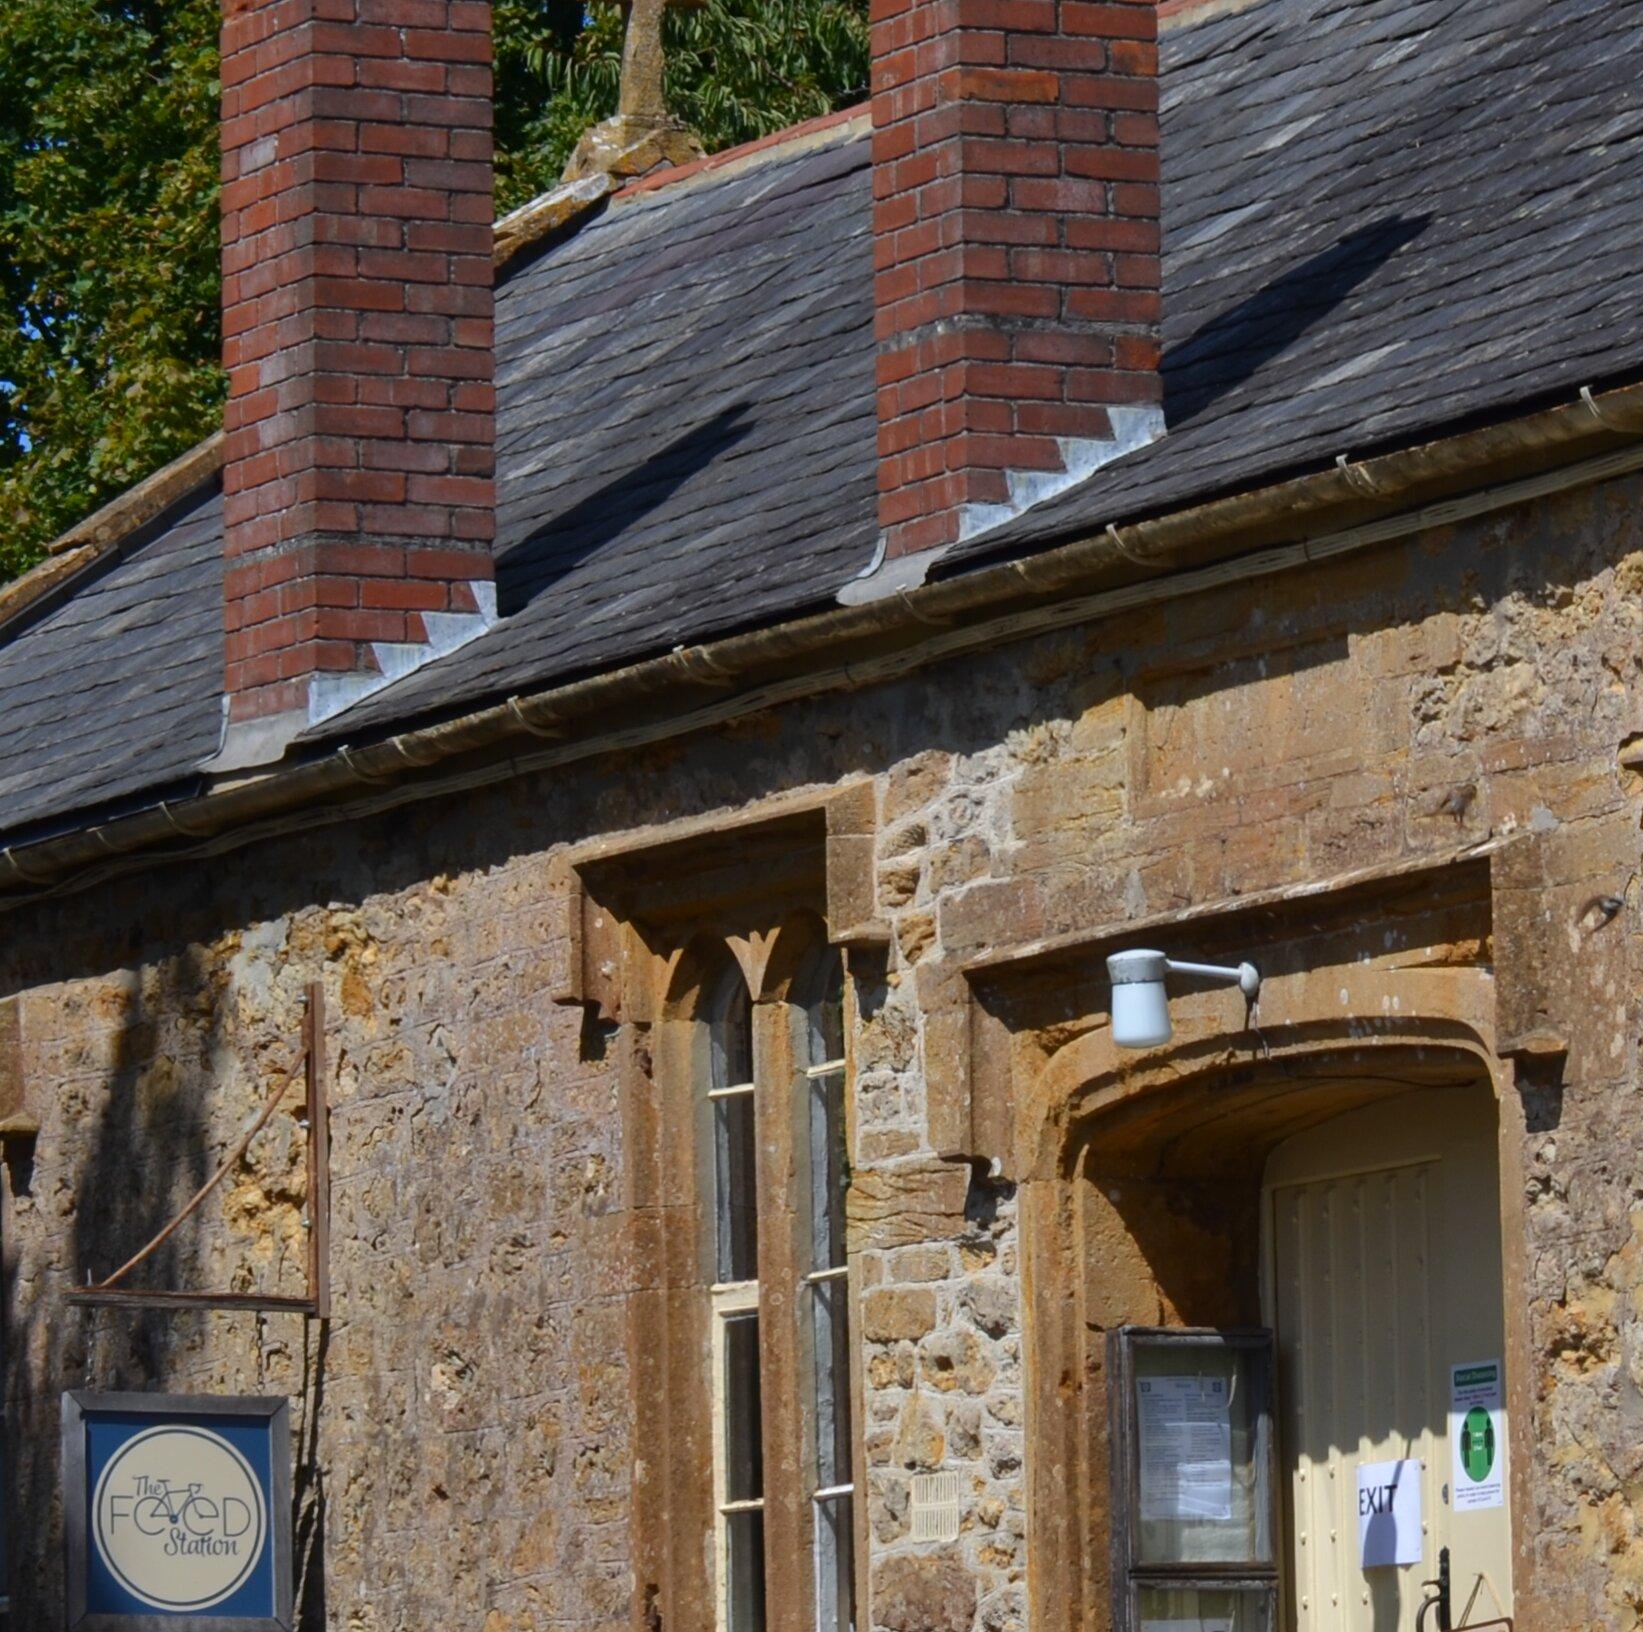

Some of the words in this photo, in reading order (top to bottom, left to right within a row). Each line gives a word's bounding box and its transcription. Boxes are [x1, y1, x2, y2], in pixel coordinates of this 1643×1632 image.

[132, 1475, 162, 1496] The
[1358, 1483, 1397, 1516] EXIT
[163, 1526, 239, 1557] Station
